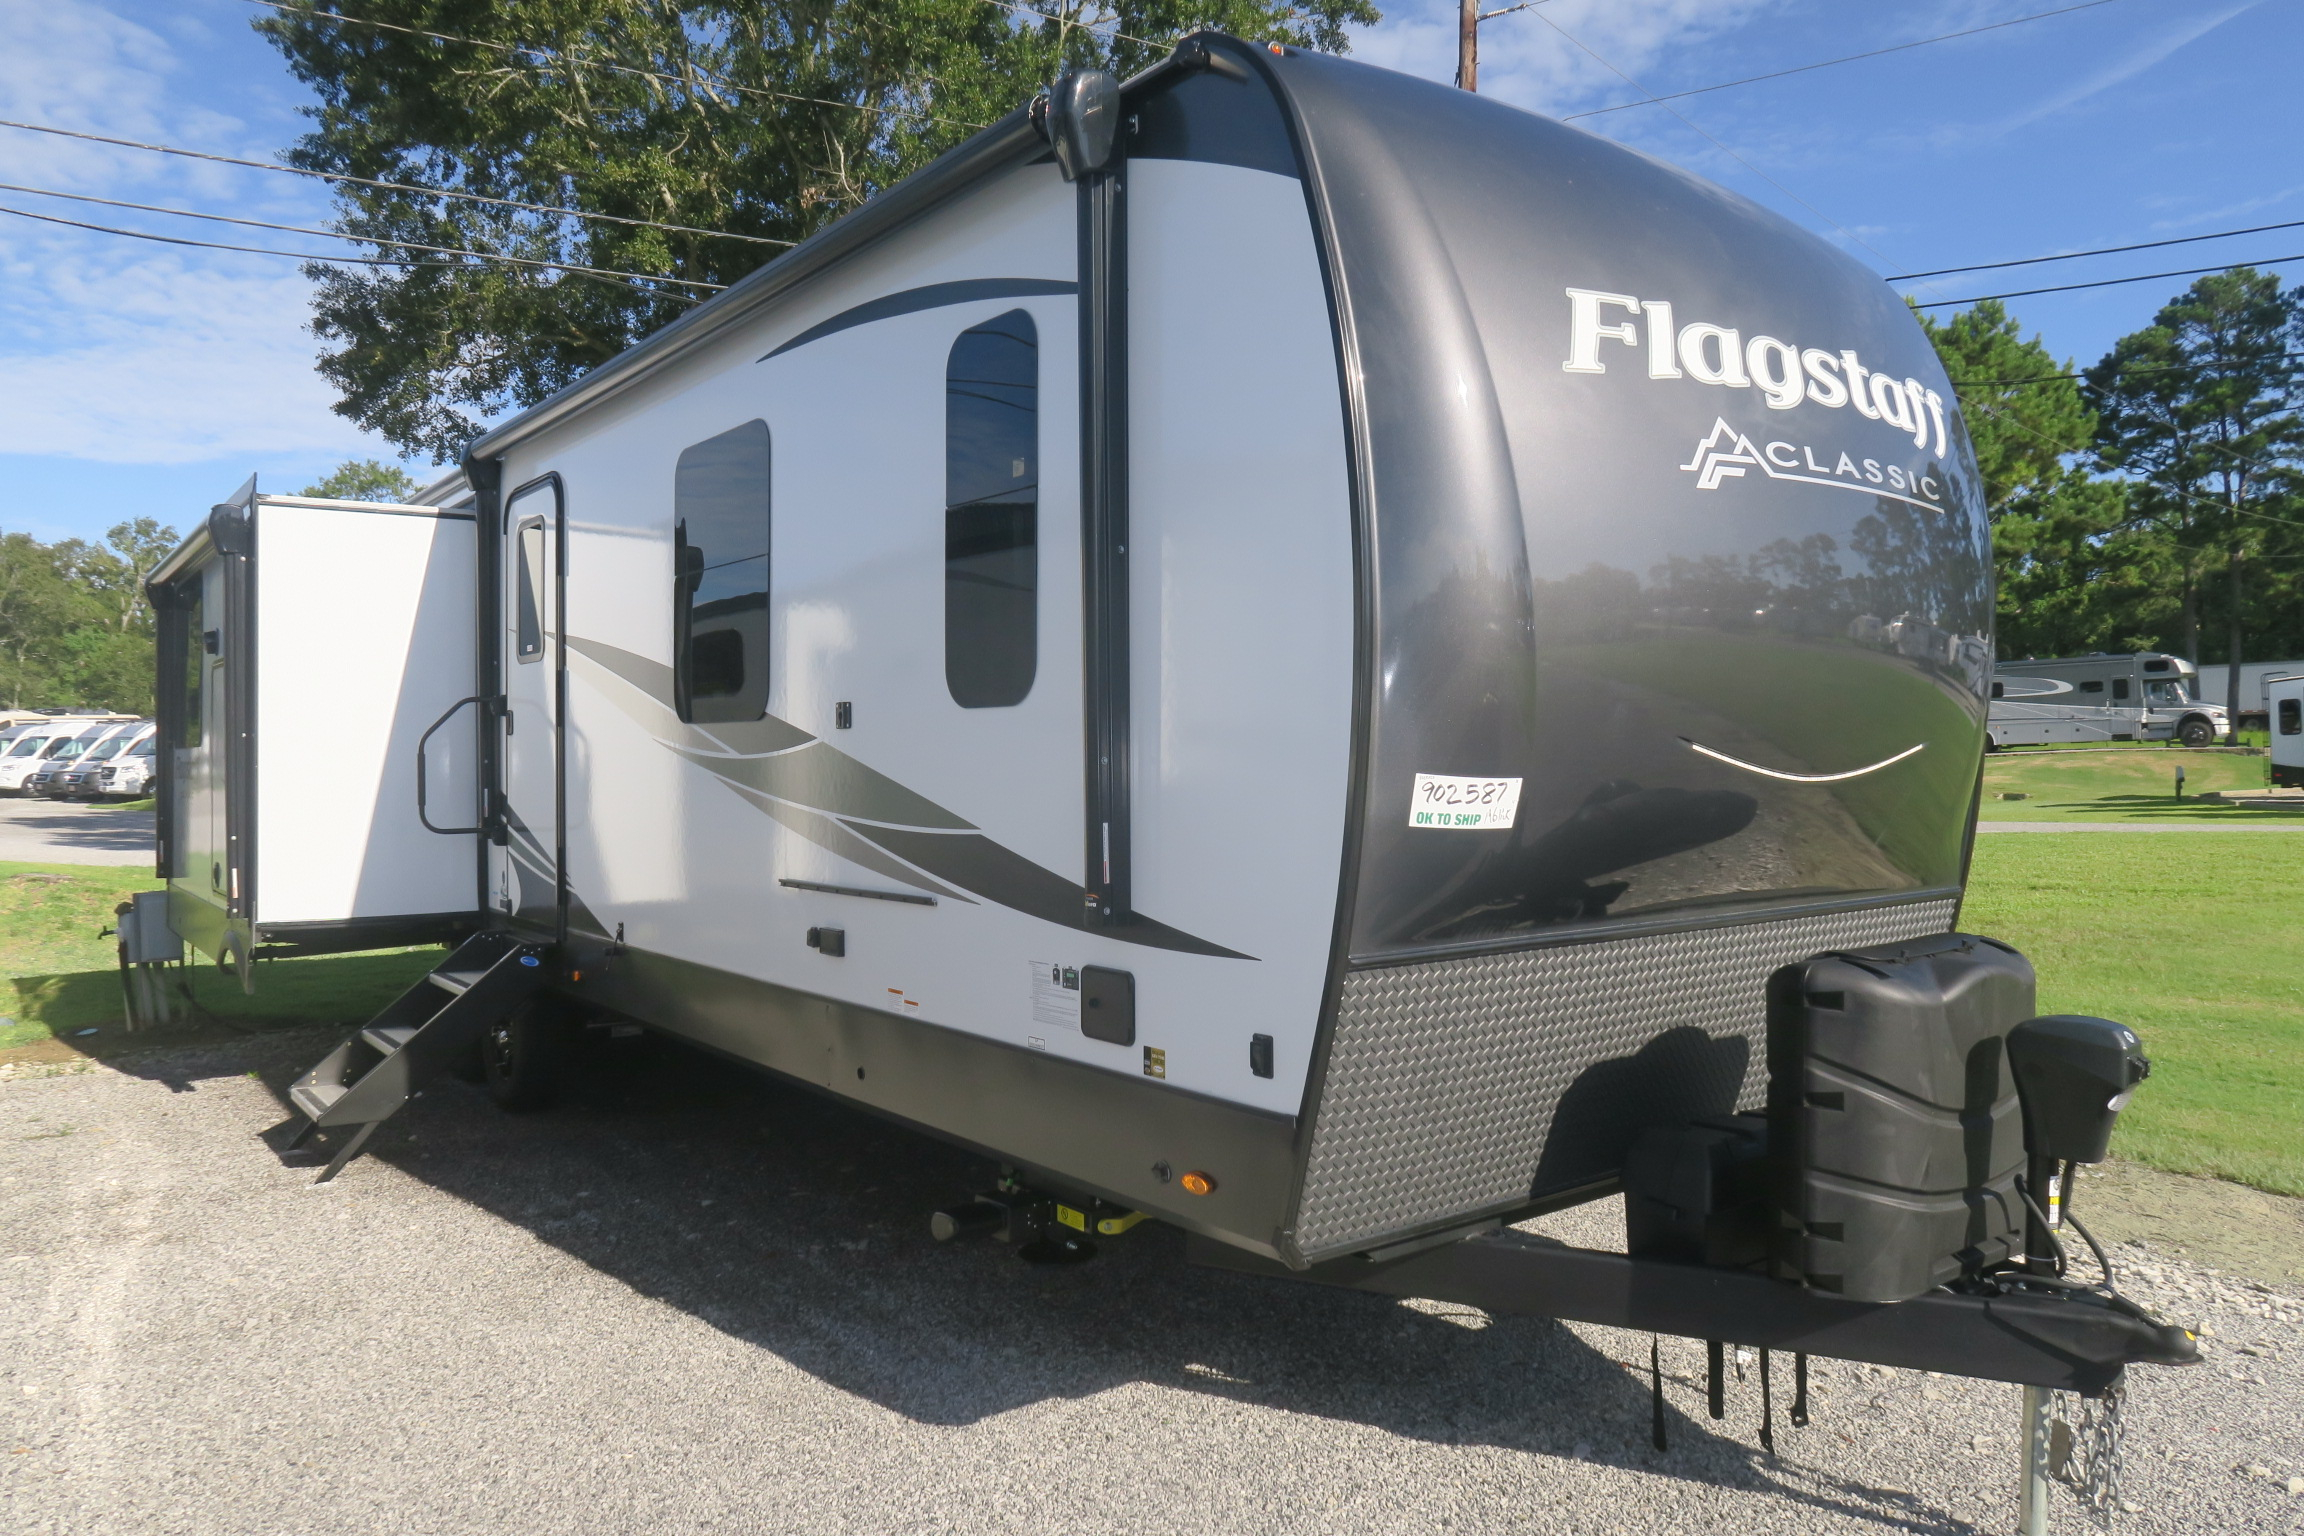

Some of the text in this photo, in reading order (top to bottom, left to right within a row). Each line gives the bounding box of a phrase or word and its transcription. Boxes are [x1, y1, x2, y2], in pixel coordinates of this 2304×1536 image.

[1562, 287, 1945, 459] Flagstaff
[1765, 441, 1940, 500] CLASSIC
[1421, 781, 1508, 805] 902587
[1416, 812, 1433, 824] OK
[1437, 813, 1452, 825] TO
[1454, 814, 1481, 825] SHIP
